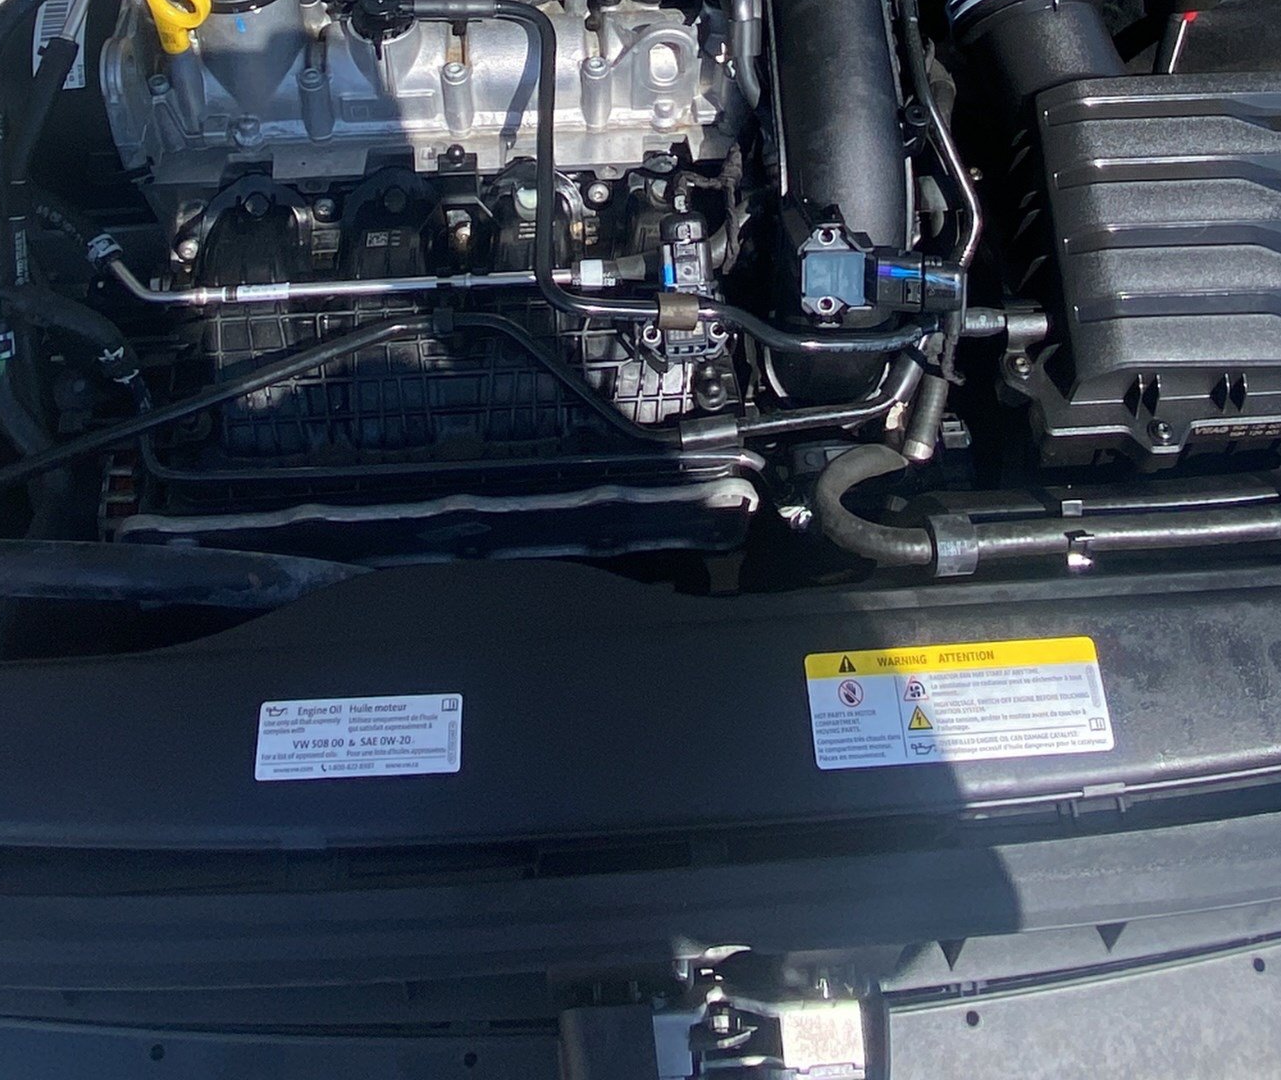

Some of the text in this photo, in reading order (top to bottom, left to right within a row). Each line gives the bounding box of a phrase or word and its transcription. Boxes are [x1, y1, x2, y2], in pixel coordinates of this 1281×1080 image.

[877, 651, 994, 666] WARNING ATTENTION
[298, 705, 342, 717] Engine Oil
[350, 704, 406, 713] Huile moteur
[293, 740, 309, 749] VW
[312, 740, 329, 748] 508
[331, 739, 344, 747] 00
[361, 737, 377, 746] SAE
[380, 736, 411, 745] 0W-20
